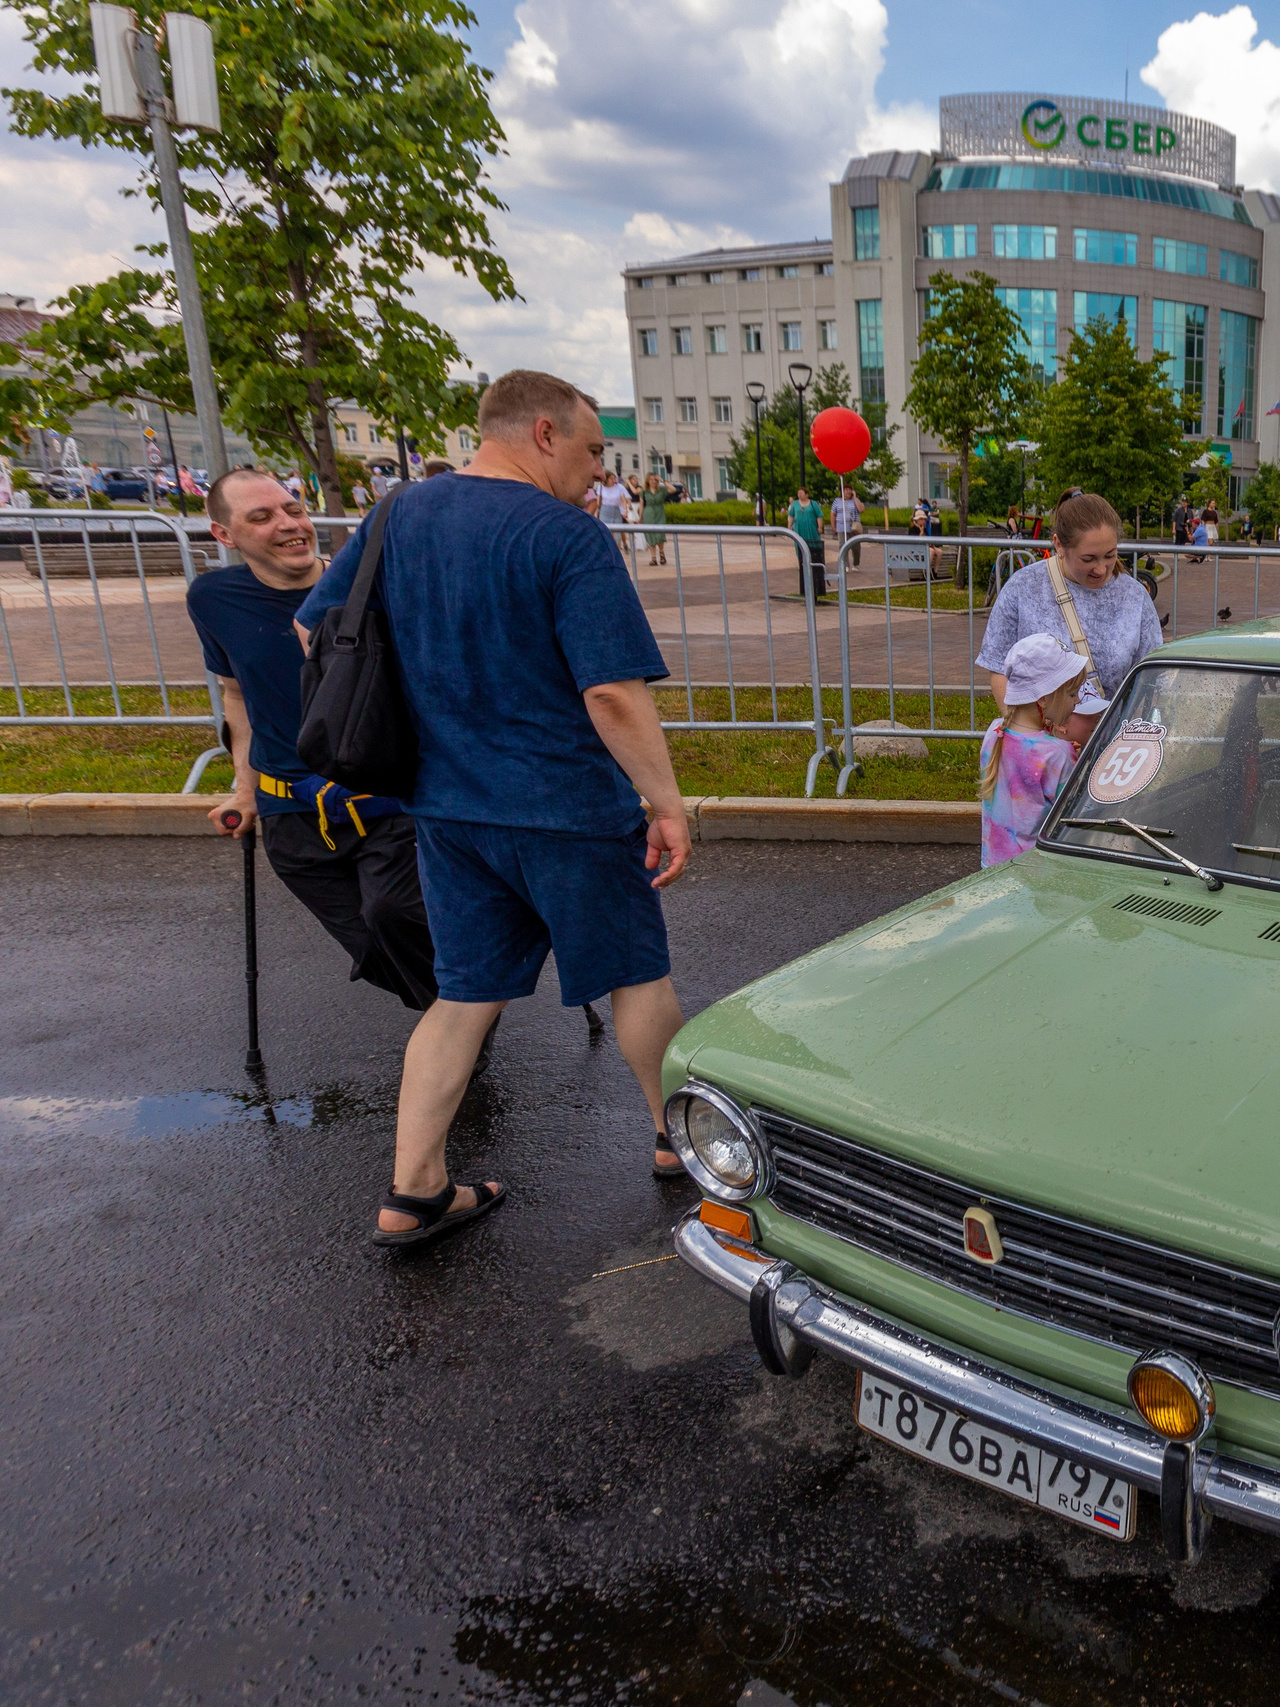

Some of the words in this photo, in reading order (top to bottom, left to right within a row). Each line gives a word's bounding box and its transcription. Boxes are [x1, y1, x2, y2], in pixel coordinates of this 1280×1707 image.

[1076, 114, 1176, 156] СБЕР
[1098, 746, 1149, 787] 59
[874, 1385, 1034, 1494] Т876ВА
[1058, 1492, 1093, 1518] RUS
